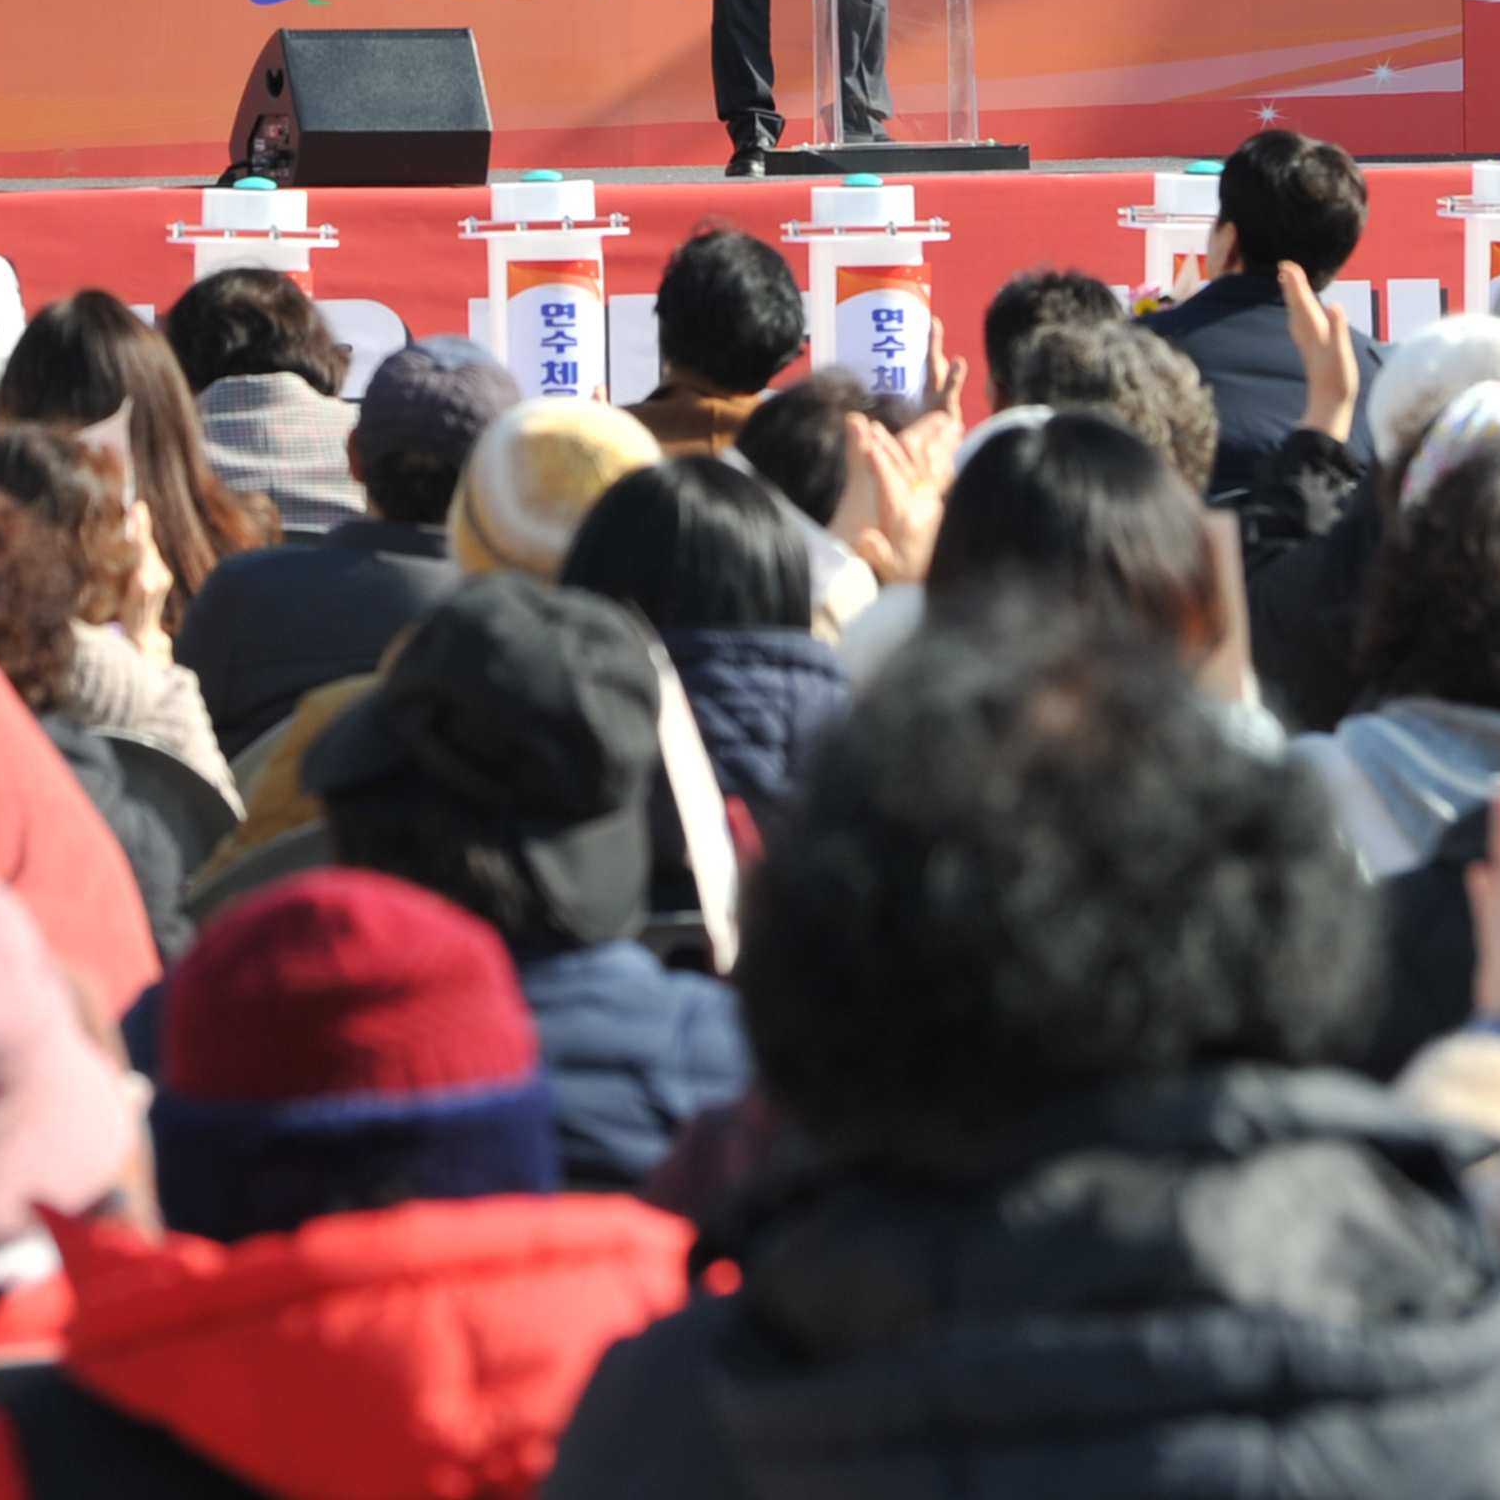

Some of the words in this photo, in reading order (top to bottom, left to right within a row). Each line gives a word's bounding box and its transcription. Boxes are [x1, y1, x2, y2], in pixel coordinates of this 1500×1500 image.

[540, 303, 578, 354] 연수
[871, 308, 905, 359] 연수
[540, 361, 578, 397] 체
